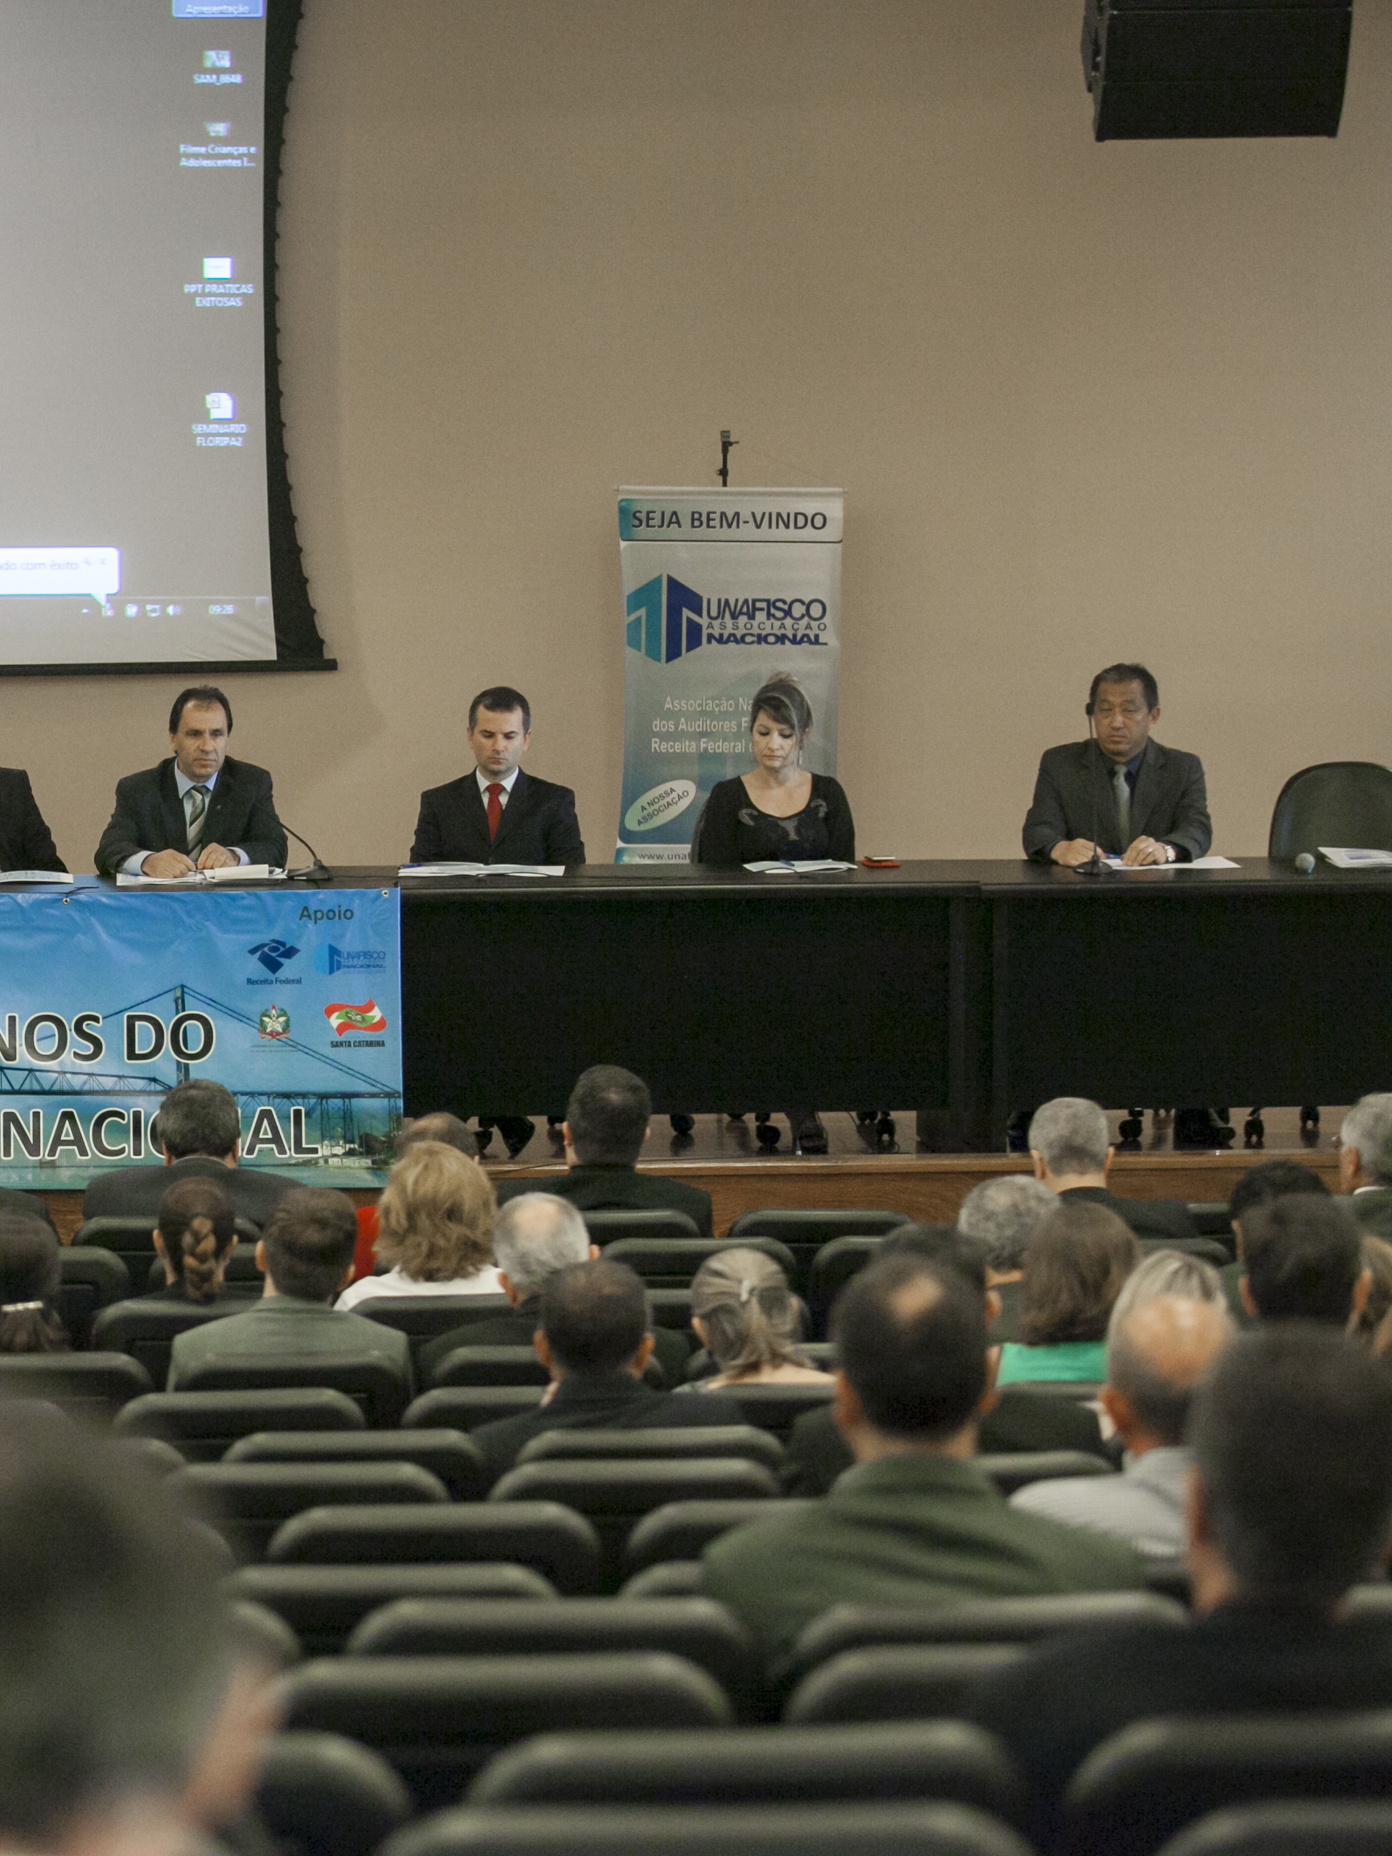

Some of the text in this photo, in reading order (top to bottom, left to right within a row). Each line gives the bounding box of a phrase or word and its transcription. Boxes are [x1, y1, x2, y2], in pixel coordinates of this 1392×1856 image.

[631, 510, 828, 530] SEJA BEM-VINDO
[706, 598, 827, 621] UNAFISCO
[706, 620, 827, 632] ASSOCIAÇÃO
[706, 632, 828, 646] NACIONAL
[664, 696, 735, 715] Associação
[652, 717, 675, 732] dos
[678, 717, 737, 732] Auditores
[651, 738, 696, 753] Receita
[700, 738, 745, 753] Federal
[637, 789, 689, 827] ASSOCIAÇÃO
[640, 787, 676, 813] A NOSSA
[299, 905, 354, 924] Apoio
[247, 976, 302, 985] Receita Federal
[124, 1011, 216, 1064] DO
[330, 1040, 385, 1049] SANTA CATARINA
[0, 1106, 322, 1161] NACIAL
